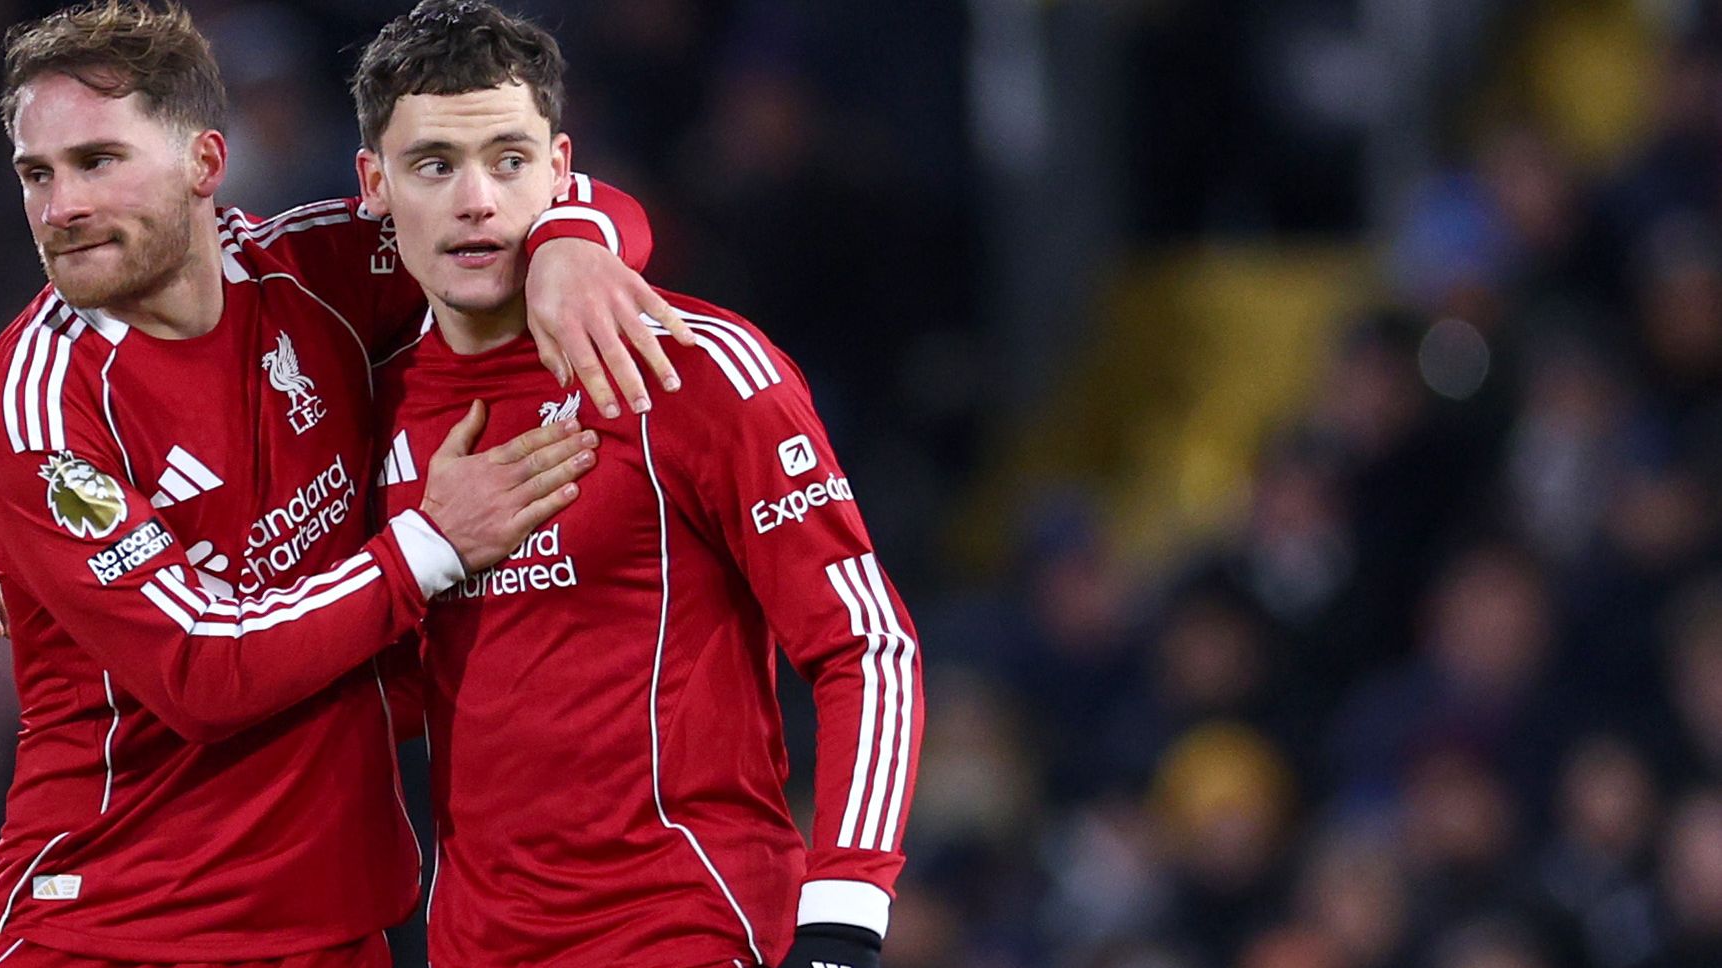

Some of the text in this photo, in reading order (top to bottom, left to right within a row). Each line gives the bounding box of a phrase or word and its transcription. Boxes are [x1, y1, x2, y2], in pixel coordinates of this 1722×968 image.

[247, 453, 348, 549] andard
[87, 522, 161, 576] No room
[97, 561, 123, 586] for
[458, 555, 577, 600] artered
